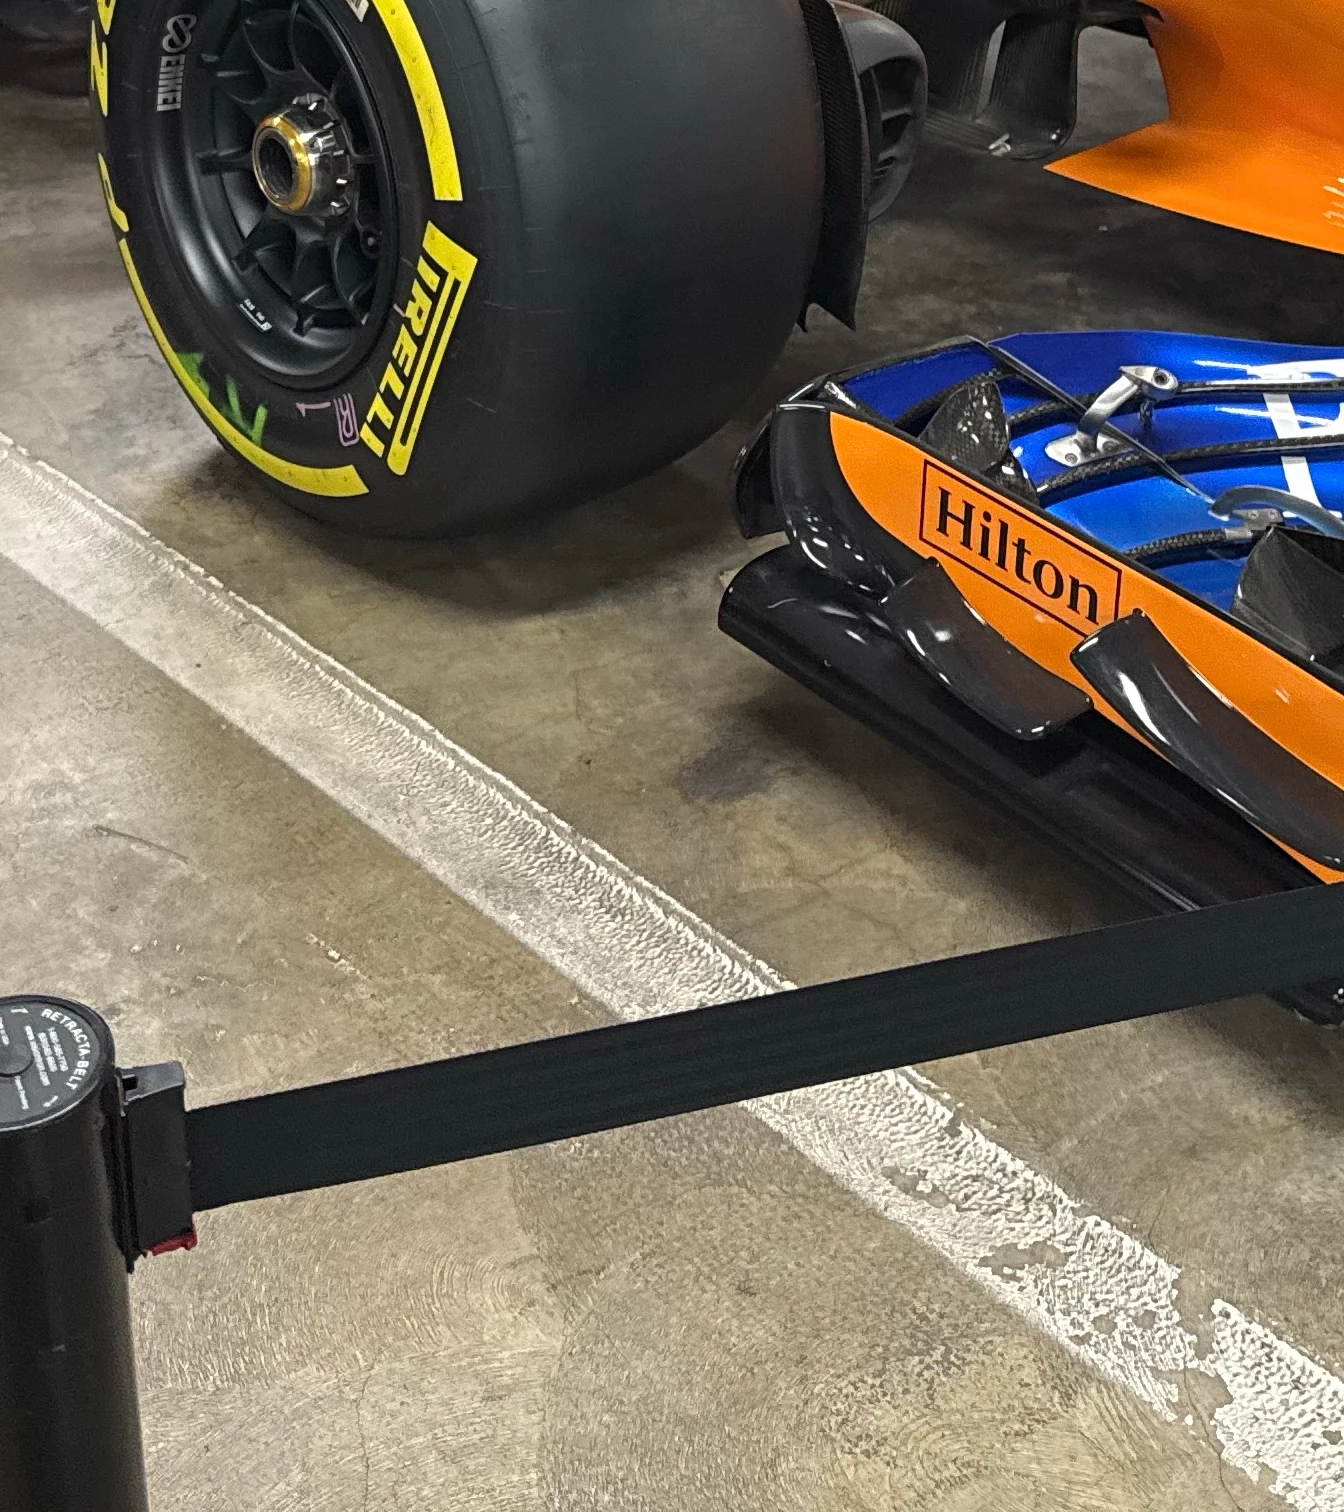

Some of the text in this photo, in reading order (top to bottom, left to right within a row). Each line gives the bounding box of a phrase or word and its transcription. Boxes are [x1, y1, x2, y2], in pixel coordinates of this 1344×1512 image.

[156, 53, 186, 112] ENKEI
[360, 219, 479, 477] PIRELLI
[933, 486, 1104, 626] Hilton
[41, 1008, 91, 1091] RETRACTA-BELT
